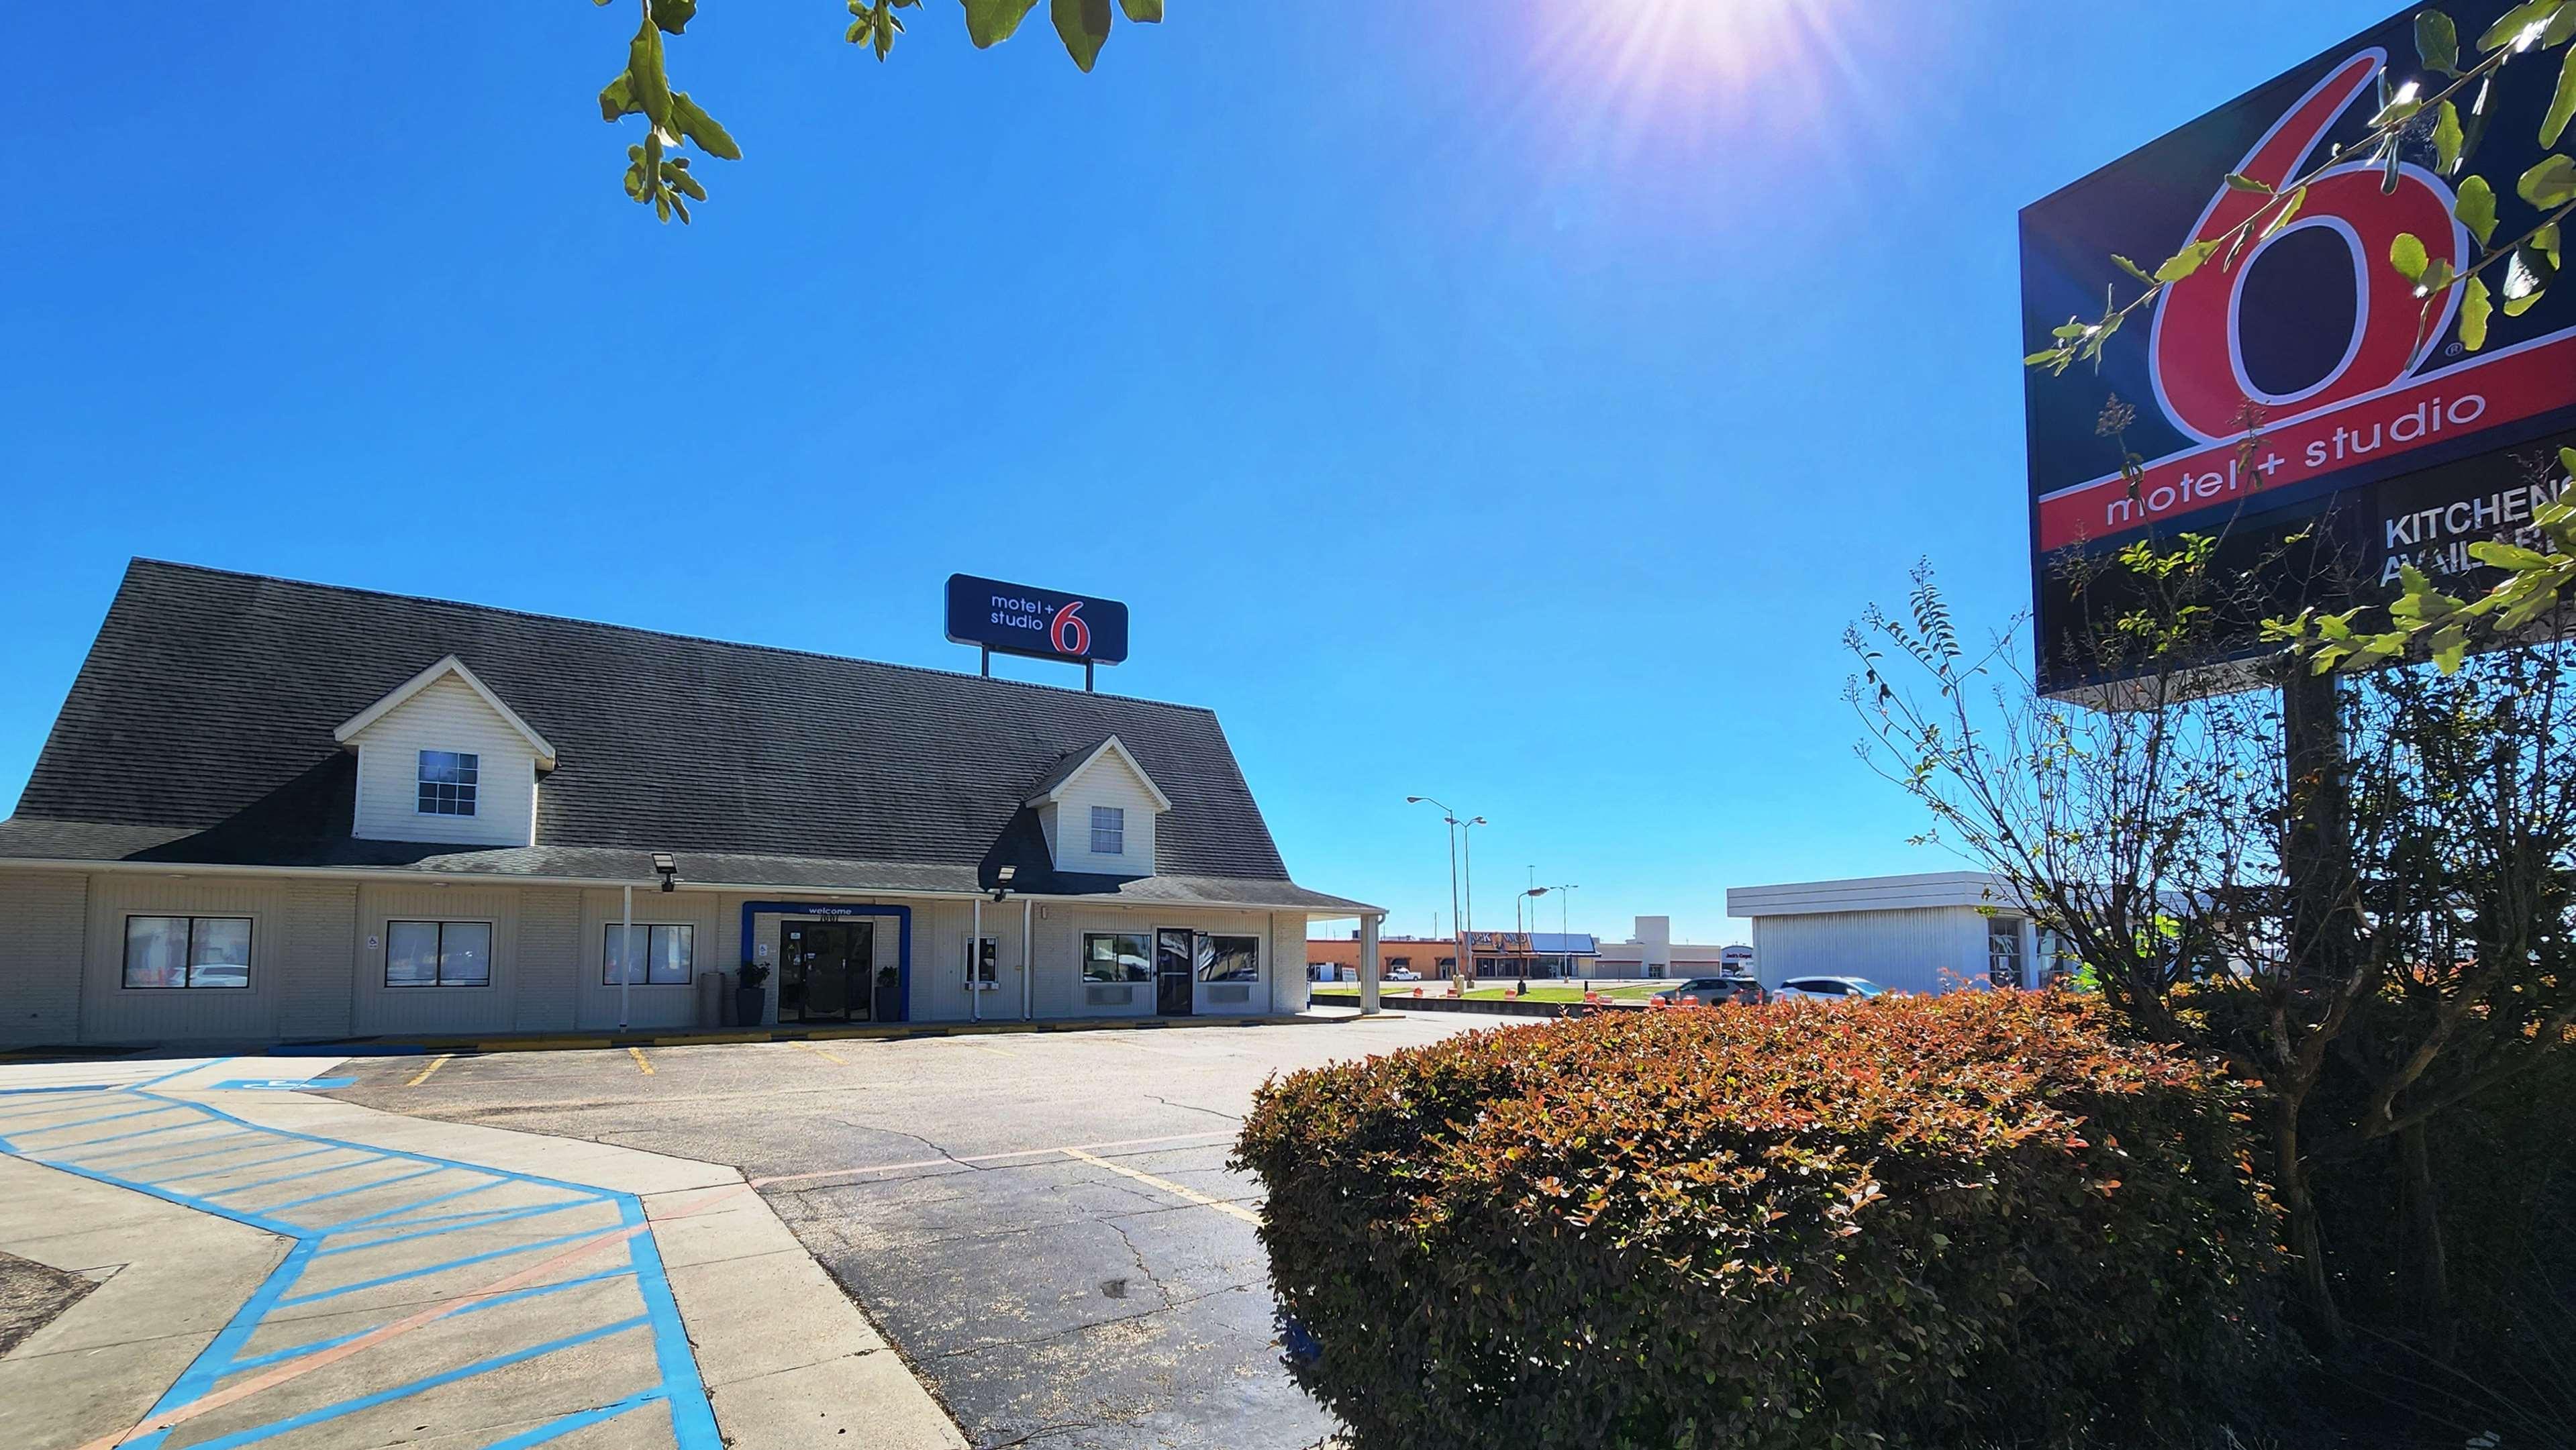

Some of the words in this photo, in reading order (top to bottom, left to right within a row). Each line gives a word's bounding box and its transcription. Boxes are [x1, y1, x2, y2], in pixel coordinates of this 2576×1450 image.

[2149, 46, 2469, 446] 6
[2106, 460, 2236, 526] motel
[2257, 452, 2285, 476] +
[2304, 395, 2486, 468] studio
[991, 595, 1041, 615] motel
[991, 611, 1043, 631] studio
[1050, 601, 1091, 656] 6
[808, 907, 852, 915] welcome
